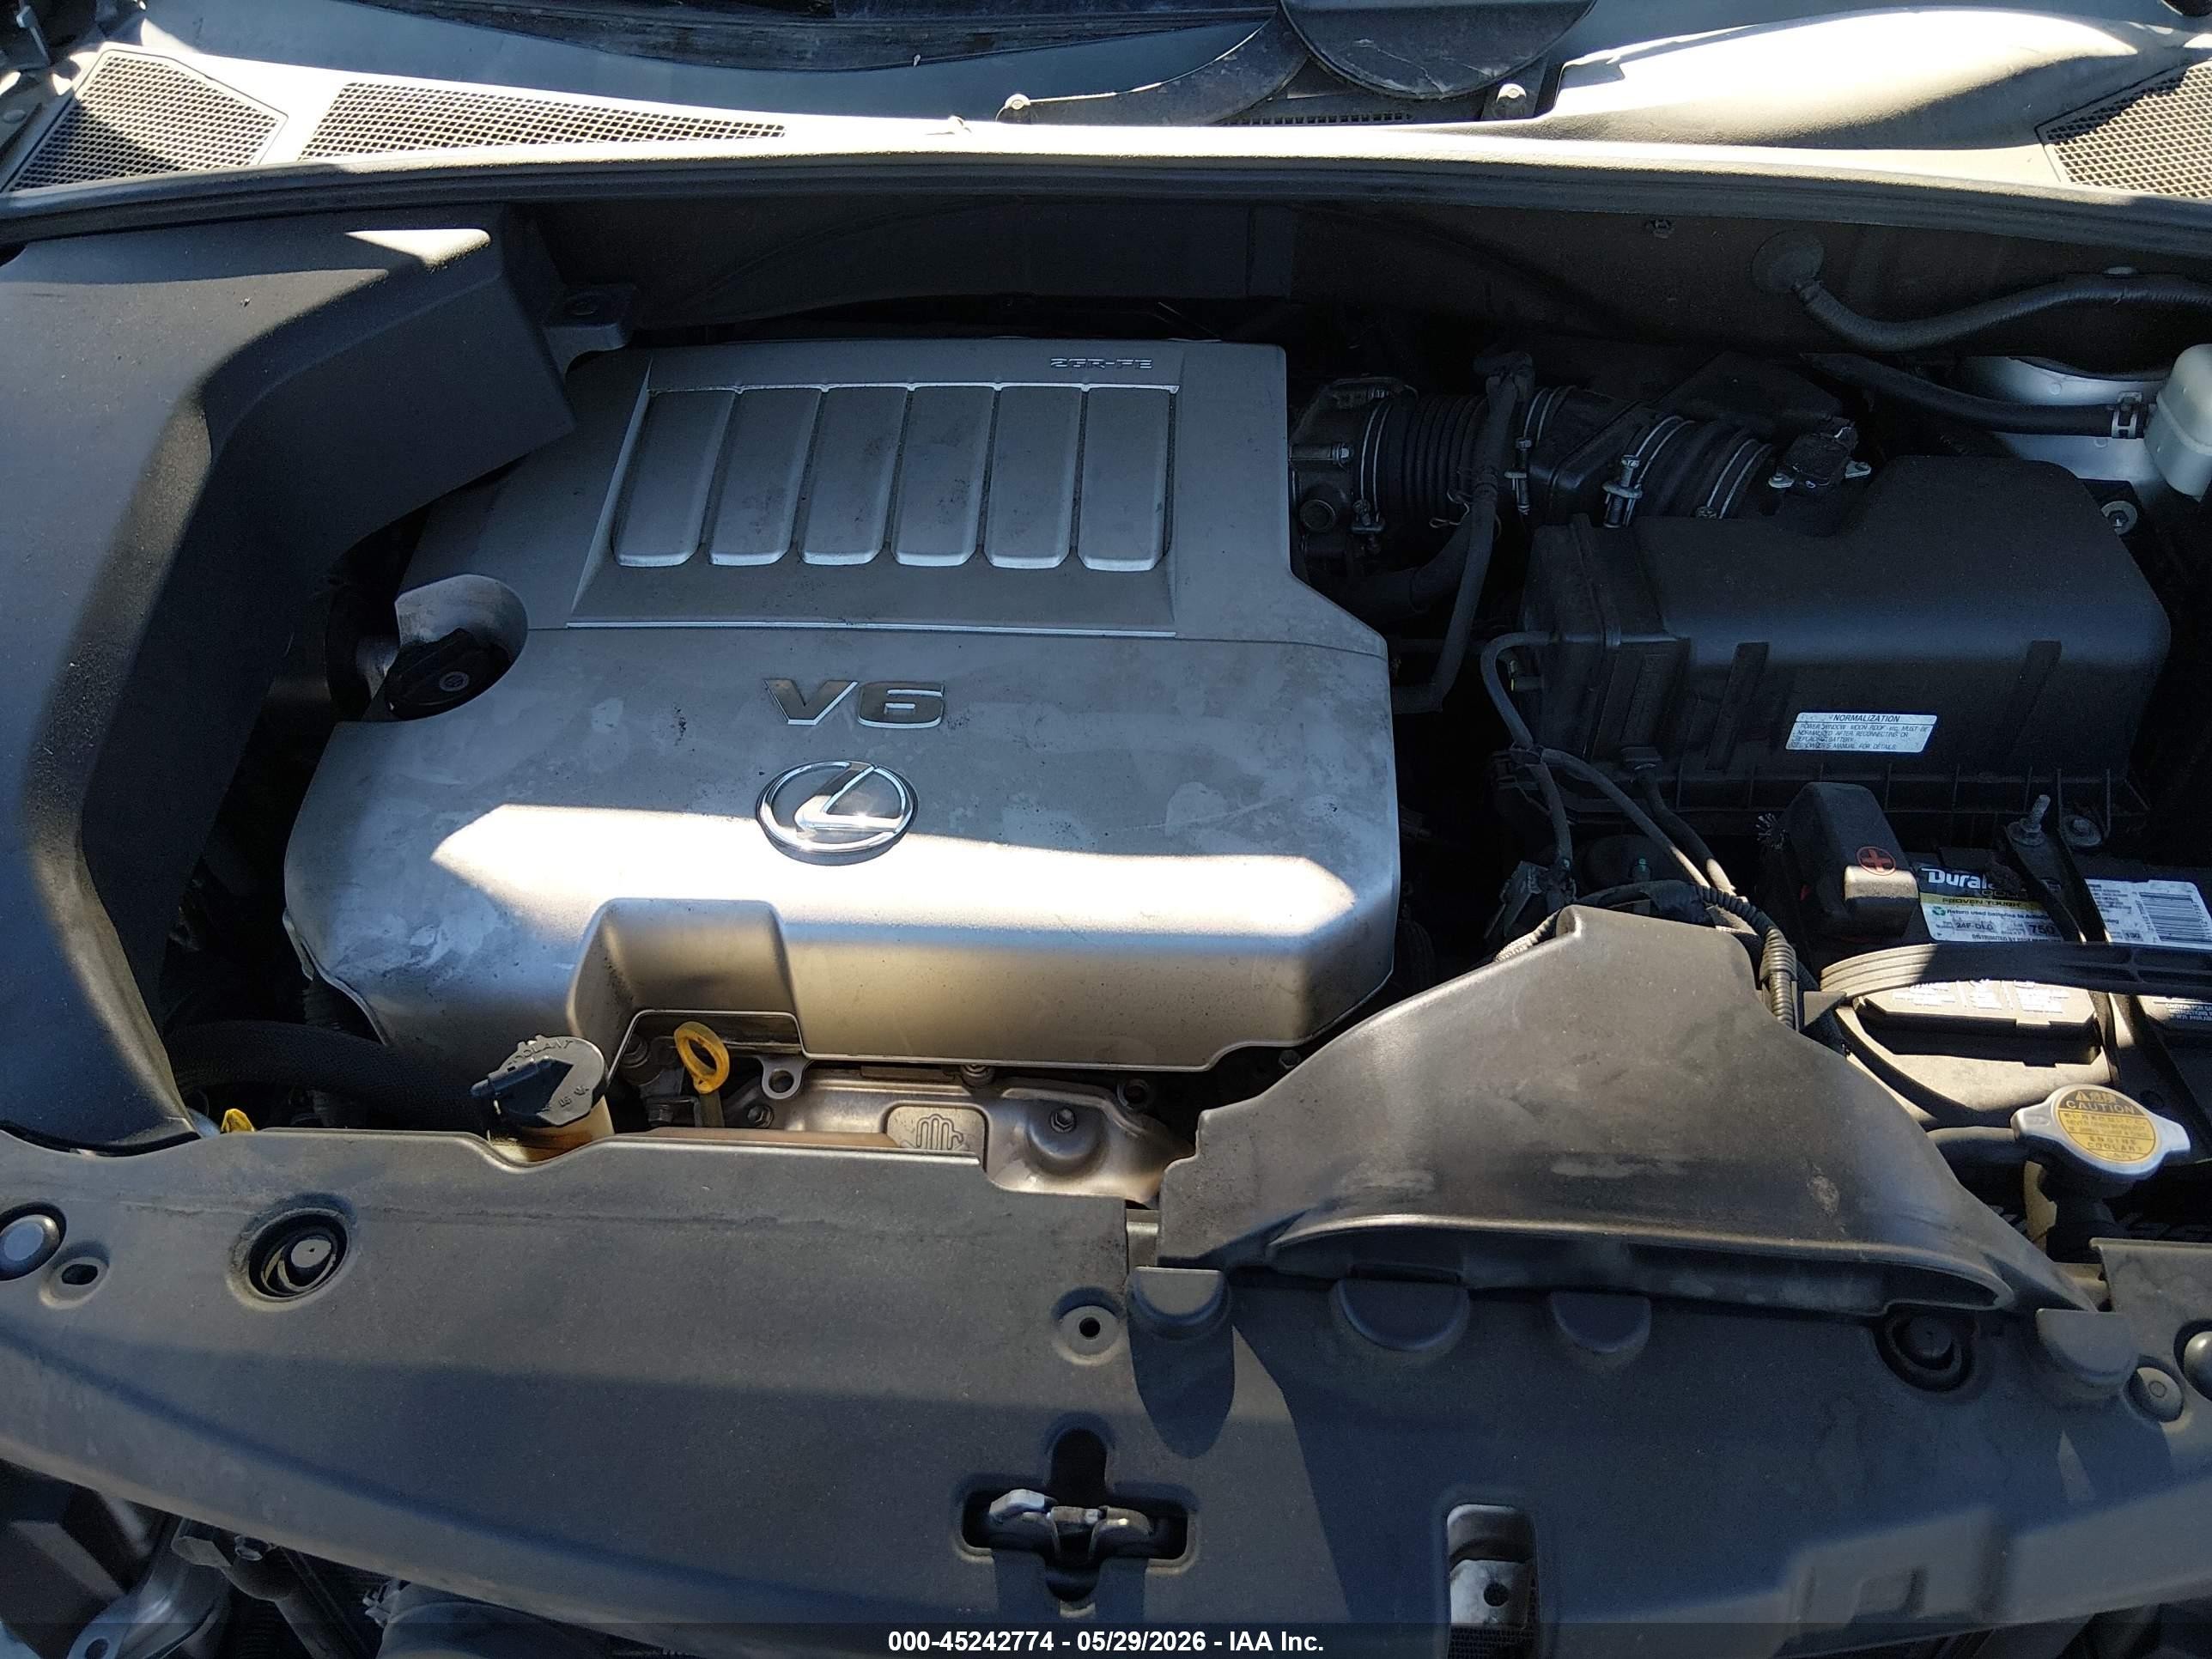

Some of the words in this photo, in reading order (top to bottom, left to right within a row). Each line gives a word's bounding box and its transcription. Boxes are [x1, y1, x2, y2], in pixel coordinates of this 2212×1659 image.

[1050, 358, 1152, 369] 2GR-FE
[763, 678, 945, 728] V6
[1833, 714, 1900, 722] NORMALIZATION
[2028, 924, 2055, 934] 750
[2065, 1100, 2136, 1114] CAUTION
[2088, 1136, 2137, 1145] ENGINE
